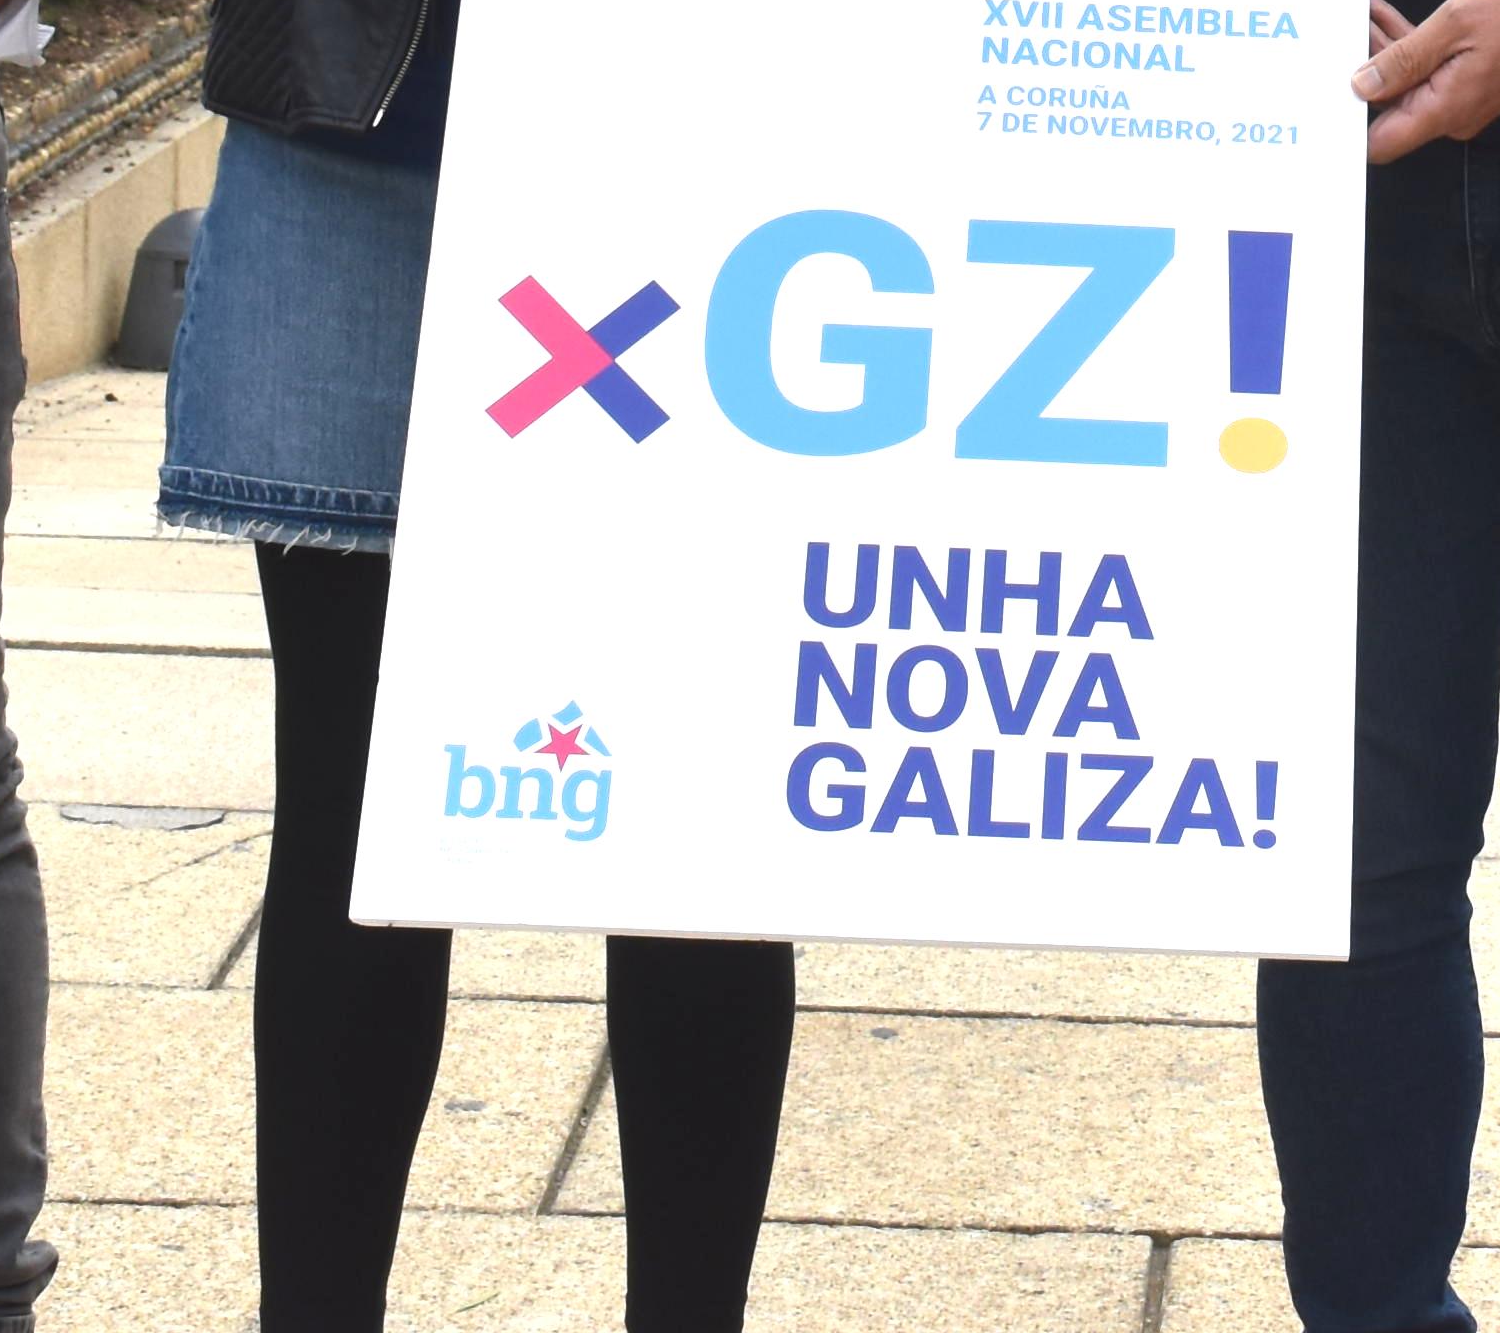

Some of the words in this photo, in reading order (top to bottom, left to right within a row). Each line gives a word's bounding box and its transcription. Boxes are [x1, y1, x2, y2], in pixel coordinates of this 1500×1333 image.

[981, 36, 1196, 73] NACIONAL
[983, 0, 1064, 30] XVII
[1076, 3, 1300, 40] ASEMBLEA
[976, 111, 993, 132] 7
[1002, 113, 1039, 134] DE
[1047, 115, 1221, 146] NOVEMBRO,
[1231, 123, 1299, 145] 2021
[977, 84, 997, 105] A
[1006, 85, 1130, 111] CORUÑA
[802, 541, 1155, 641] UNHA
[793, 640, 1141, 741] NOVA
[443, 743, 613, 842] bng
[785, 741, 1280, 850] GALIZA!
